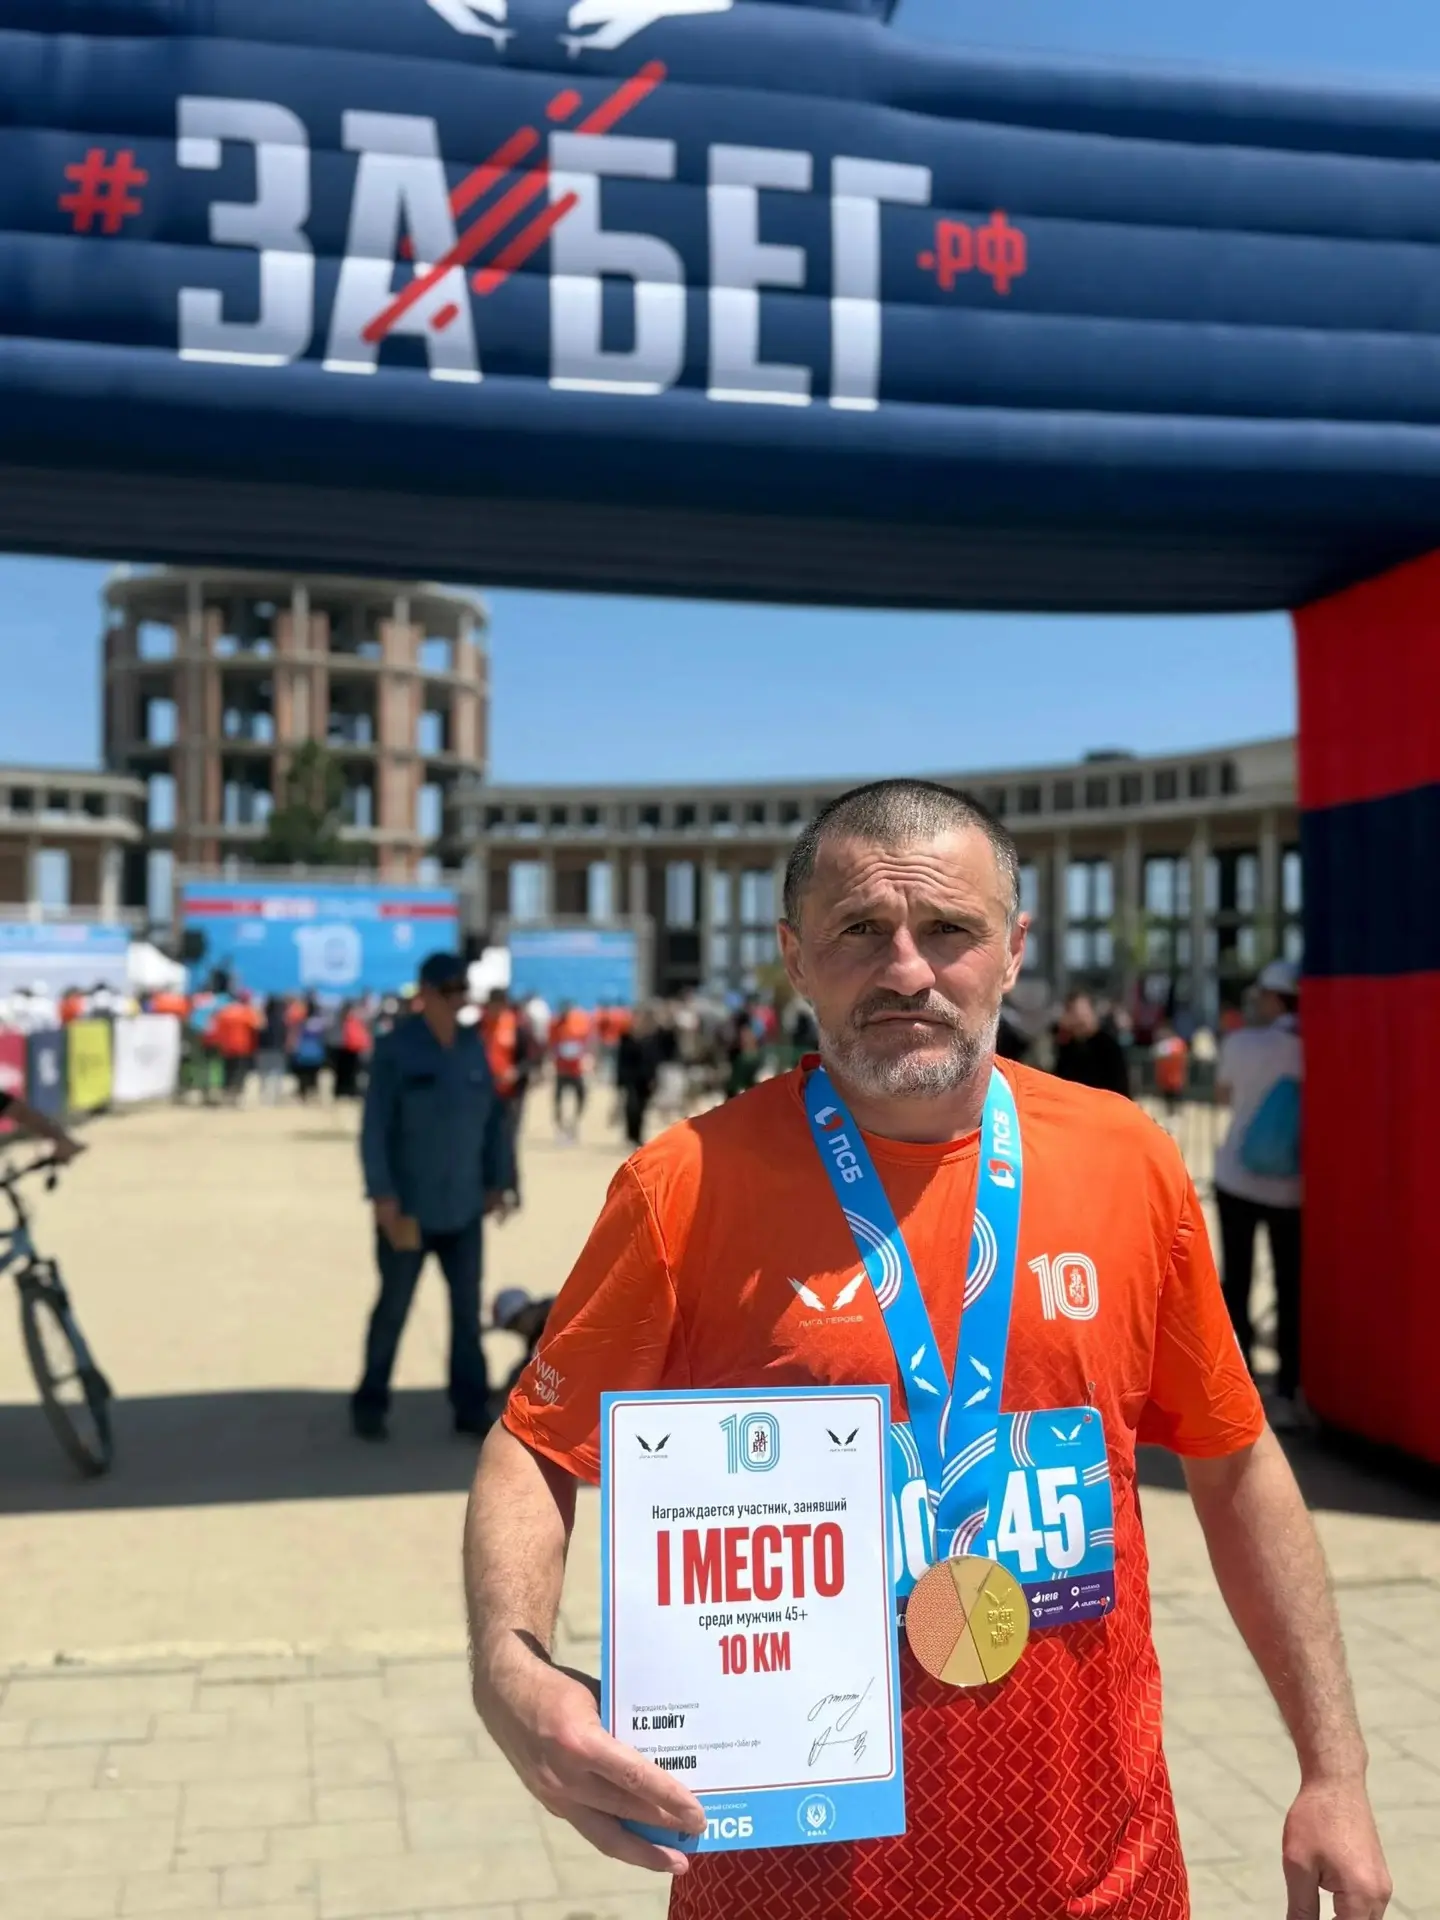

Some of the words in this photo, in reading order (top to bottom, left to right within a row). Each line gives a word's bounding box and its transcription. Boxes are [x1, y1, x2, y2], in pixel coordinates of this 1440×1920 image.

[993, 1107, 1011, 1156] ПСБ
[828, 1133, 865, 1184] ПСБ
[1027, 1252, 1099, 1320] 10
[825, 1315, 864, 1325] ГЕРОЕВ
[718, 1410, 780, 1474] 10
[652, 1505, 735, 1522] Награждается
[737, 1501, 791, 1519] участник,
[793, 1497, 847, 1513] занявший
[656, 1530, 671, 1606] I
[682, 1521, 845, 1605] МЕСТО
[698, 1612, 733, 1630] среди
[736, 1609, 782, 1628] мужчин
[785, 1606, 808, 1622] 45+
[718, 1634, 748, 1675] 10
[752, 1631, 791, 1673] КМ
[632, 1715, 651, 1731] К.С.
[652, 1712, 685, 1730] ШОЙГУ
[654, 1755, 697, 1771] АННИКОВ
[704, 1816, 754, 1841] ПСБ
